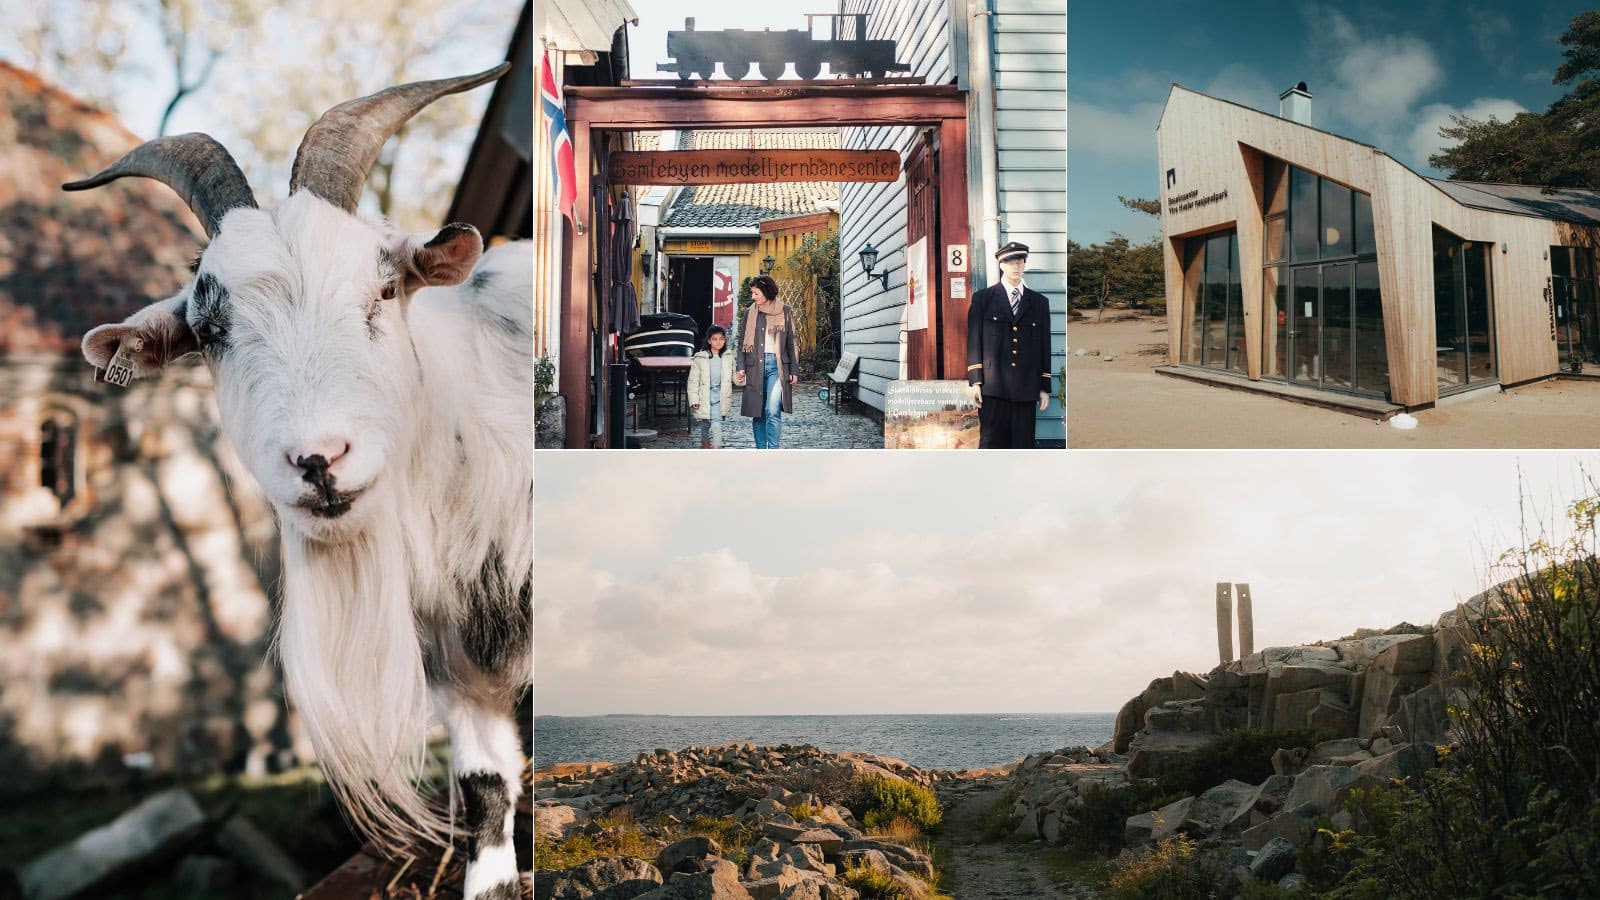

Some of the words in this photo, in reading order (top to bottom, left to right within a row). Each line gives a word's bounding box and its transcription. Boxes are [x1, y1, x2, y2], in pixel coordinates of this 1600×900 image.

[716, 156, 897, 180] modelljernbanesenter
[952, 249, 962, 266] 8
[107, 364, 133, 387] 0501
